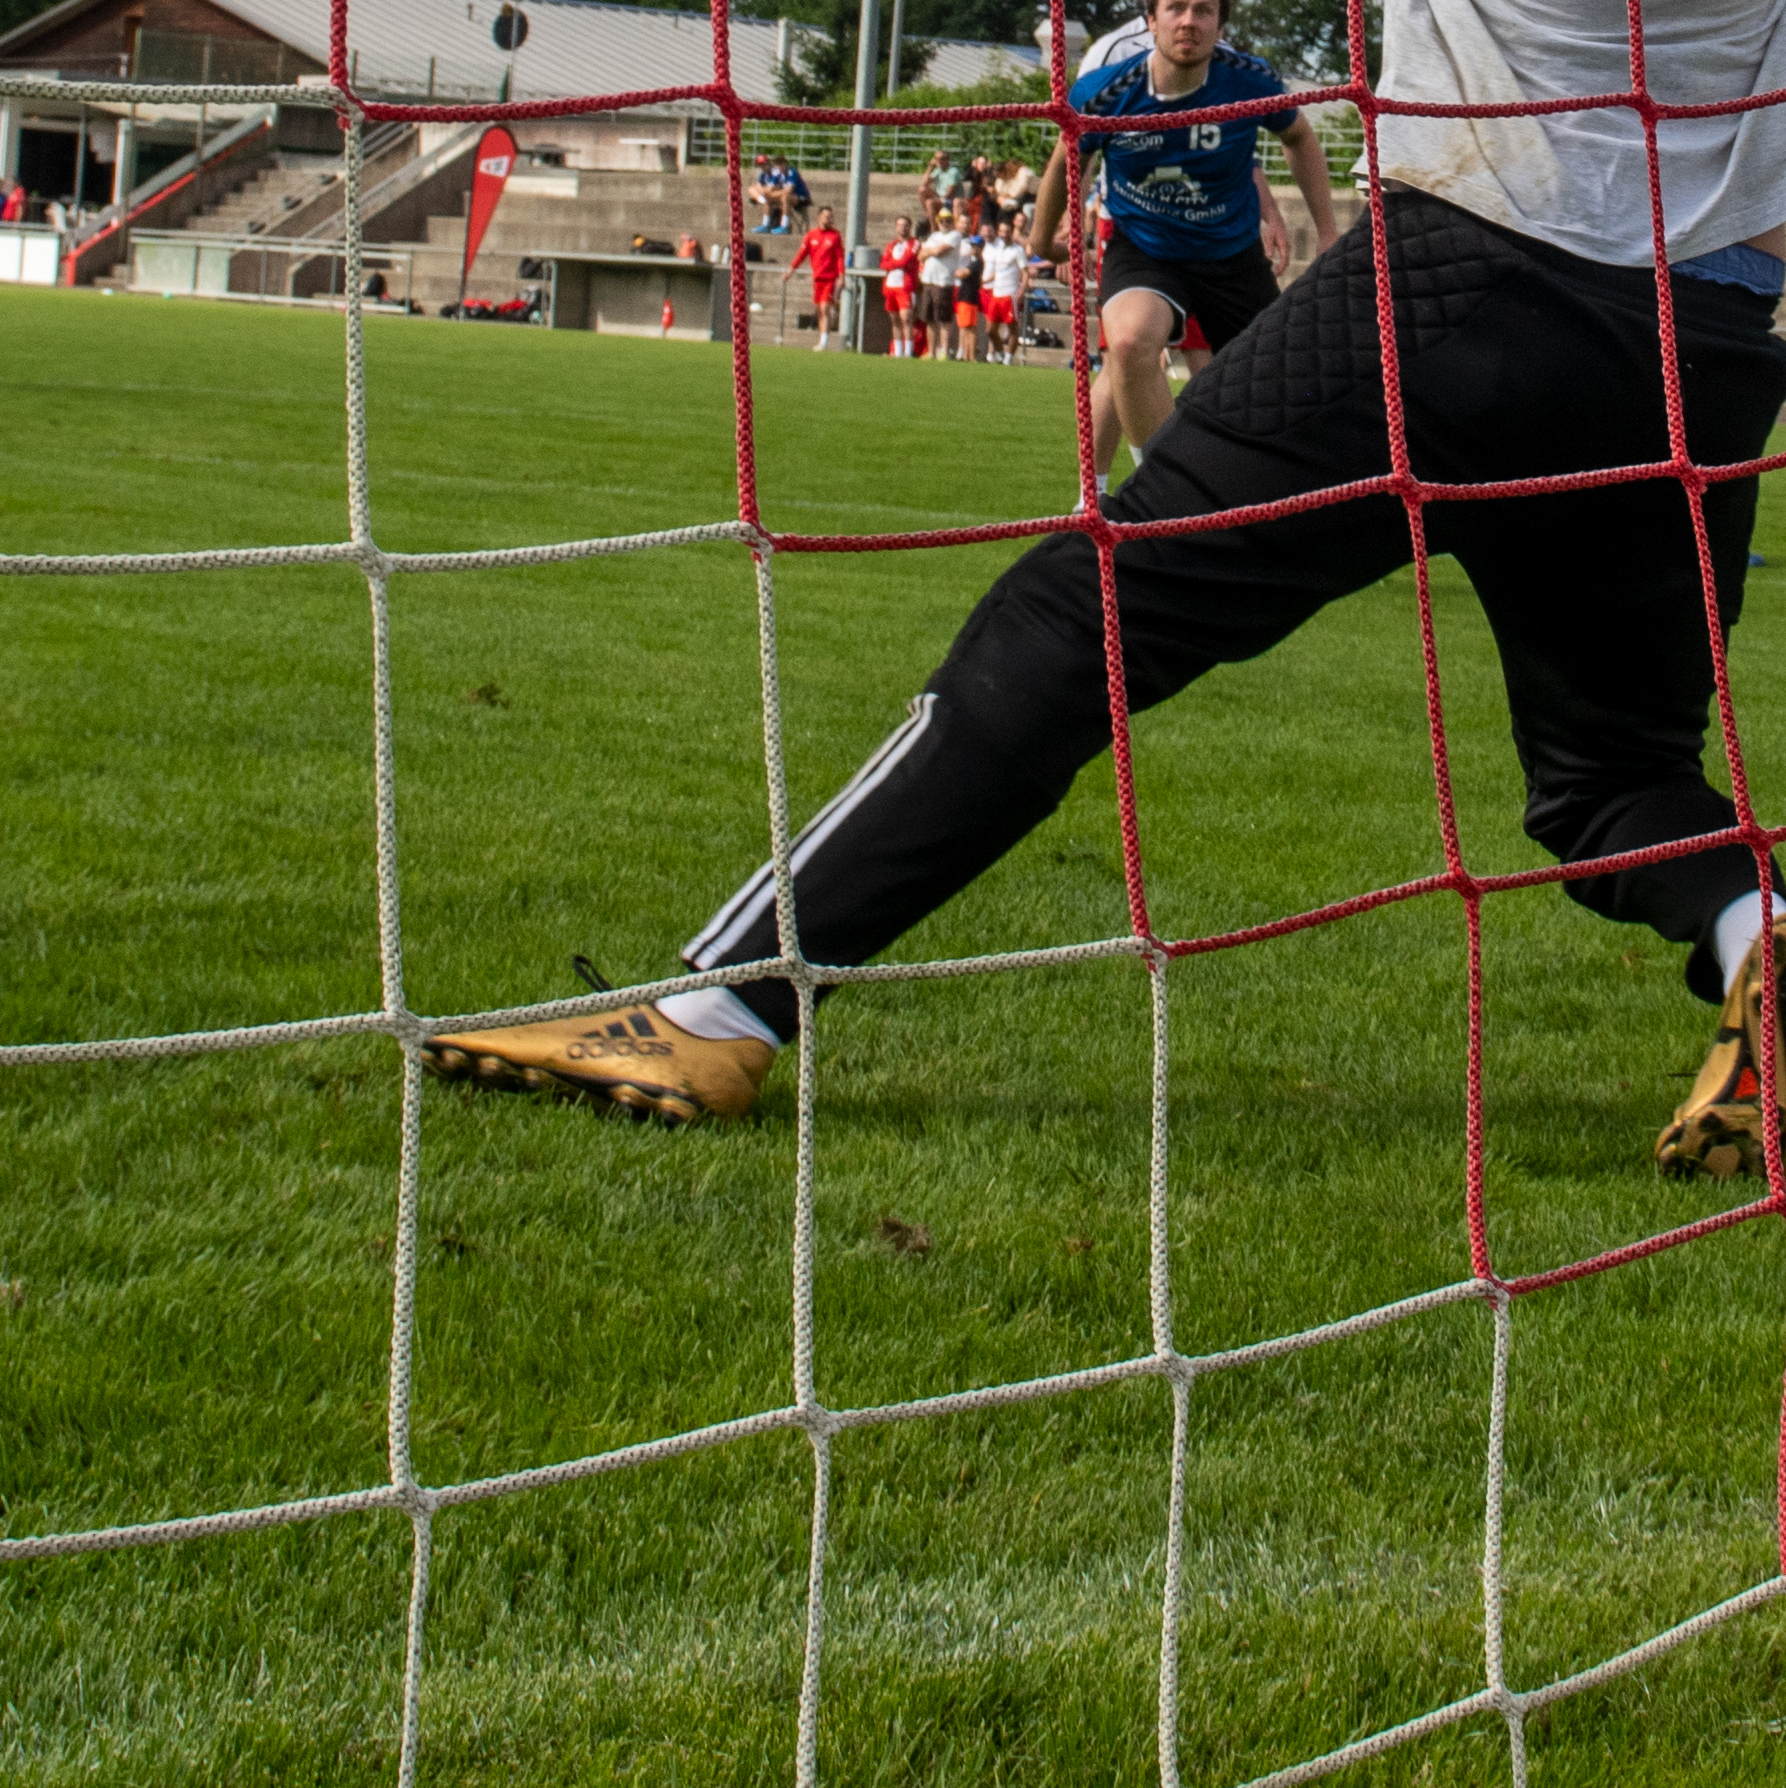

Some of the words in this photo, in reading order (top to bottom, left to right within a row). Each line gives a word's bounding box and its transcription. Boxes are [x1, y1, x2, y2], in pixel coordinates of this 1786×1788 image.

[1189, 122, 1221, 151] 15
[1184, 203, 1226, 222] GmbH
[565, 1034, 675, 1060] adidas
